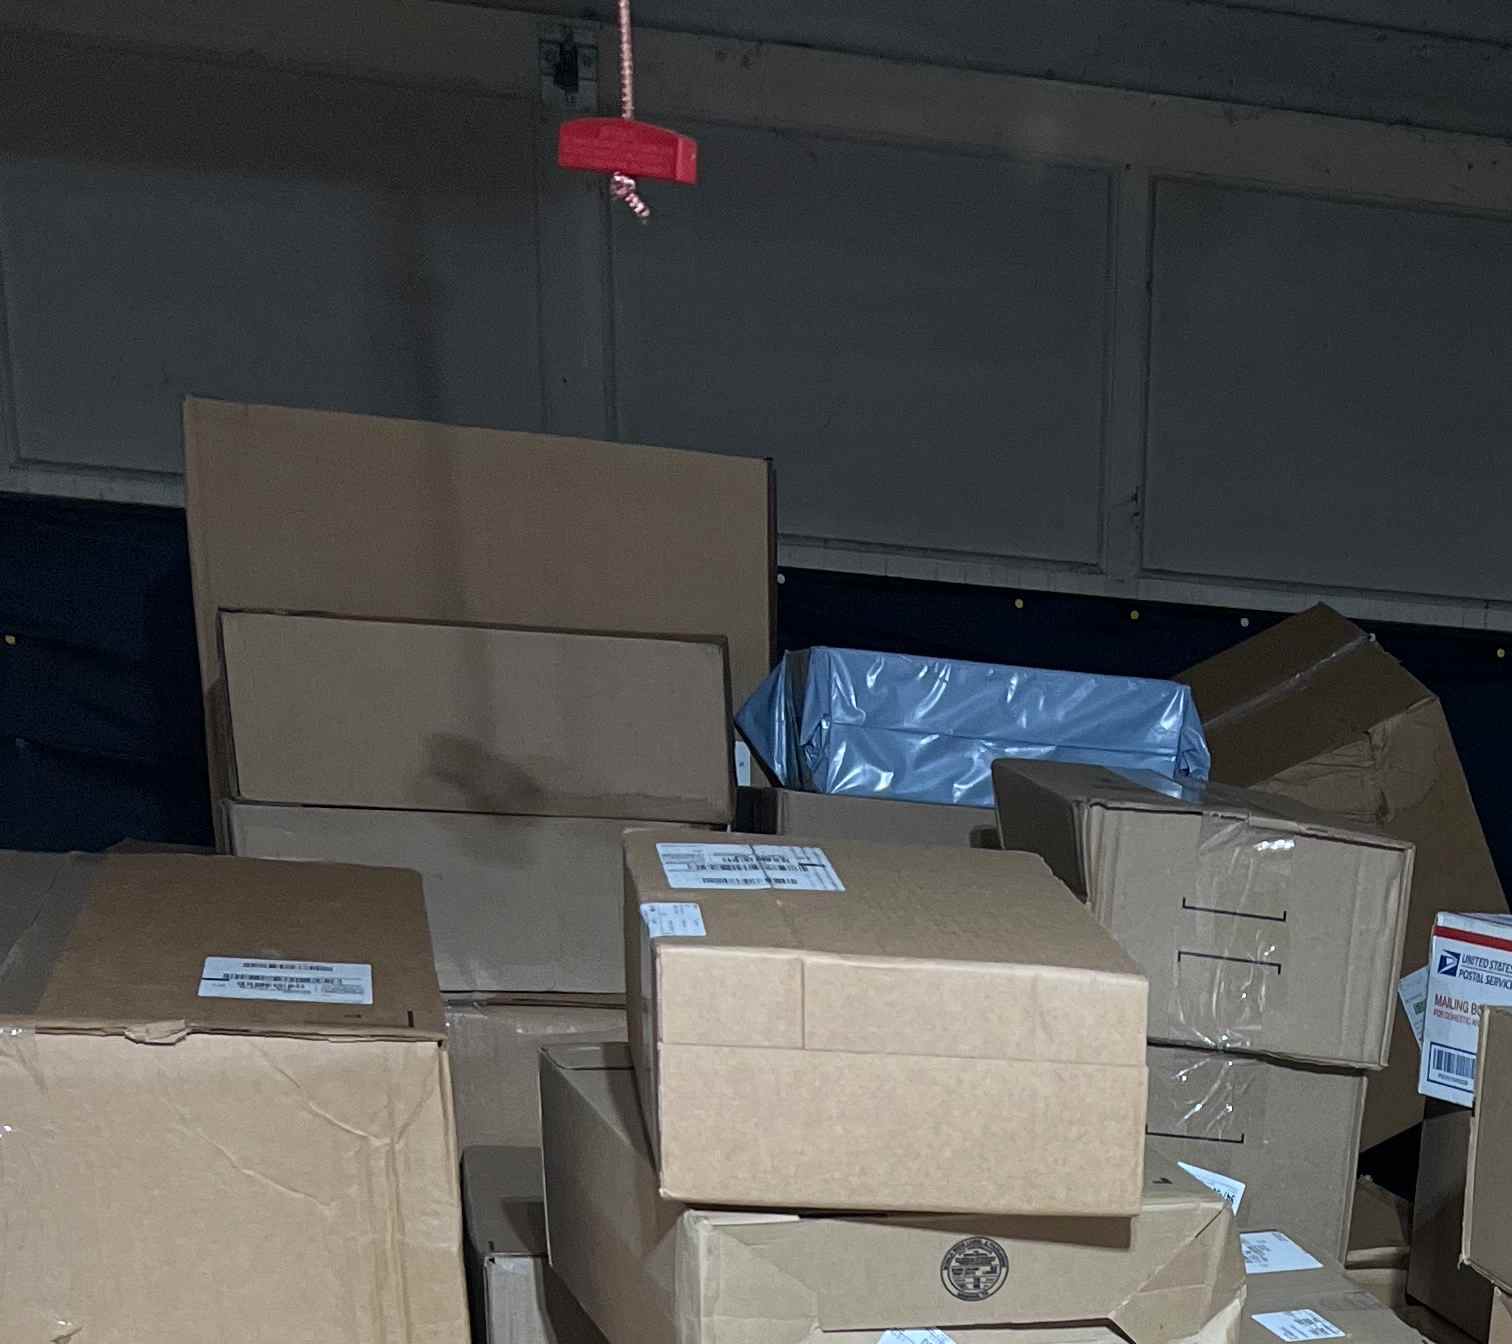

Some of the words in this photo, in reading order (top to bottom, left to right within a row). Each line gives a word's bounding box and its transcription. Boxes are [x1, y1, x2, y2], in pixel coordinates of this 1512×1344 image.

[1462, 954, 1490, 970] UNITED
[1458, 970, 1484, 985] POSTAL
[1434, 993, 1469, 1014] MAILING
